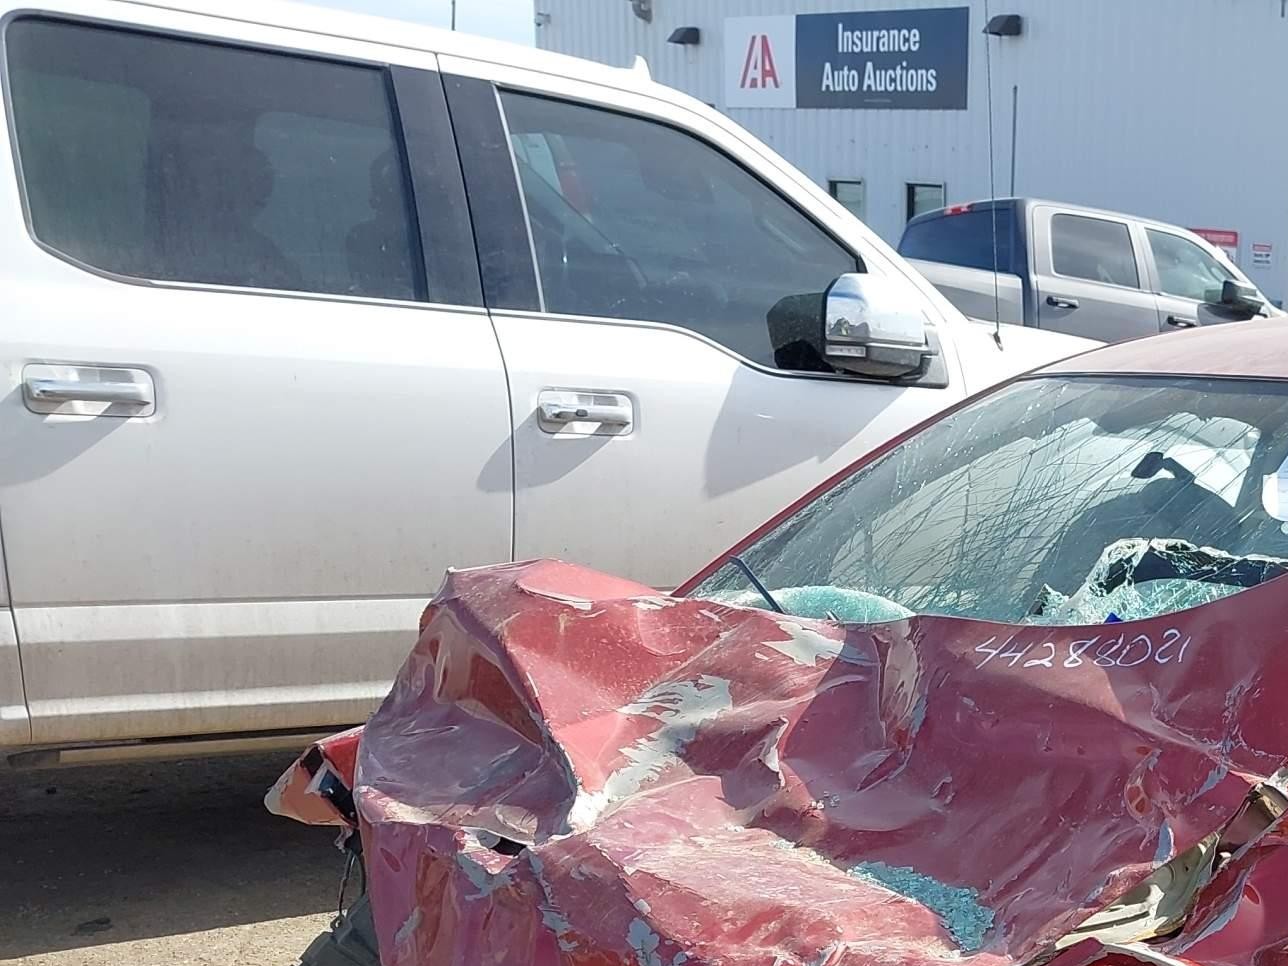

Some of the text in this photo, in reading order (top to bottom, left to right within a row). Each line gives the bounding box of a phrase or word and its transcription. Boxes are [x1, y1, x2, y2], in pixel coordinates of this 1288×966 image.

[837, 23, 920, 53] Insurance
[821, 61, 937, 92] Auto Auctions
[975, 628, 1192, 669] 44288021
